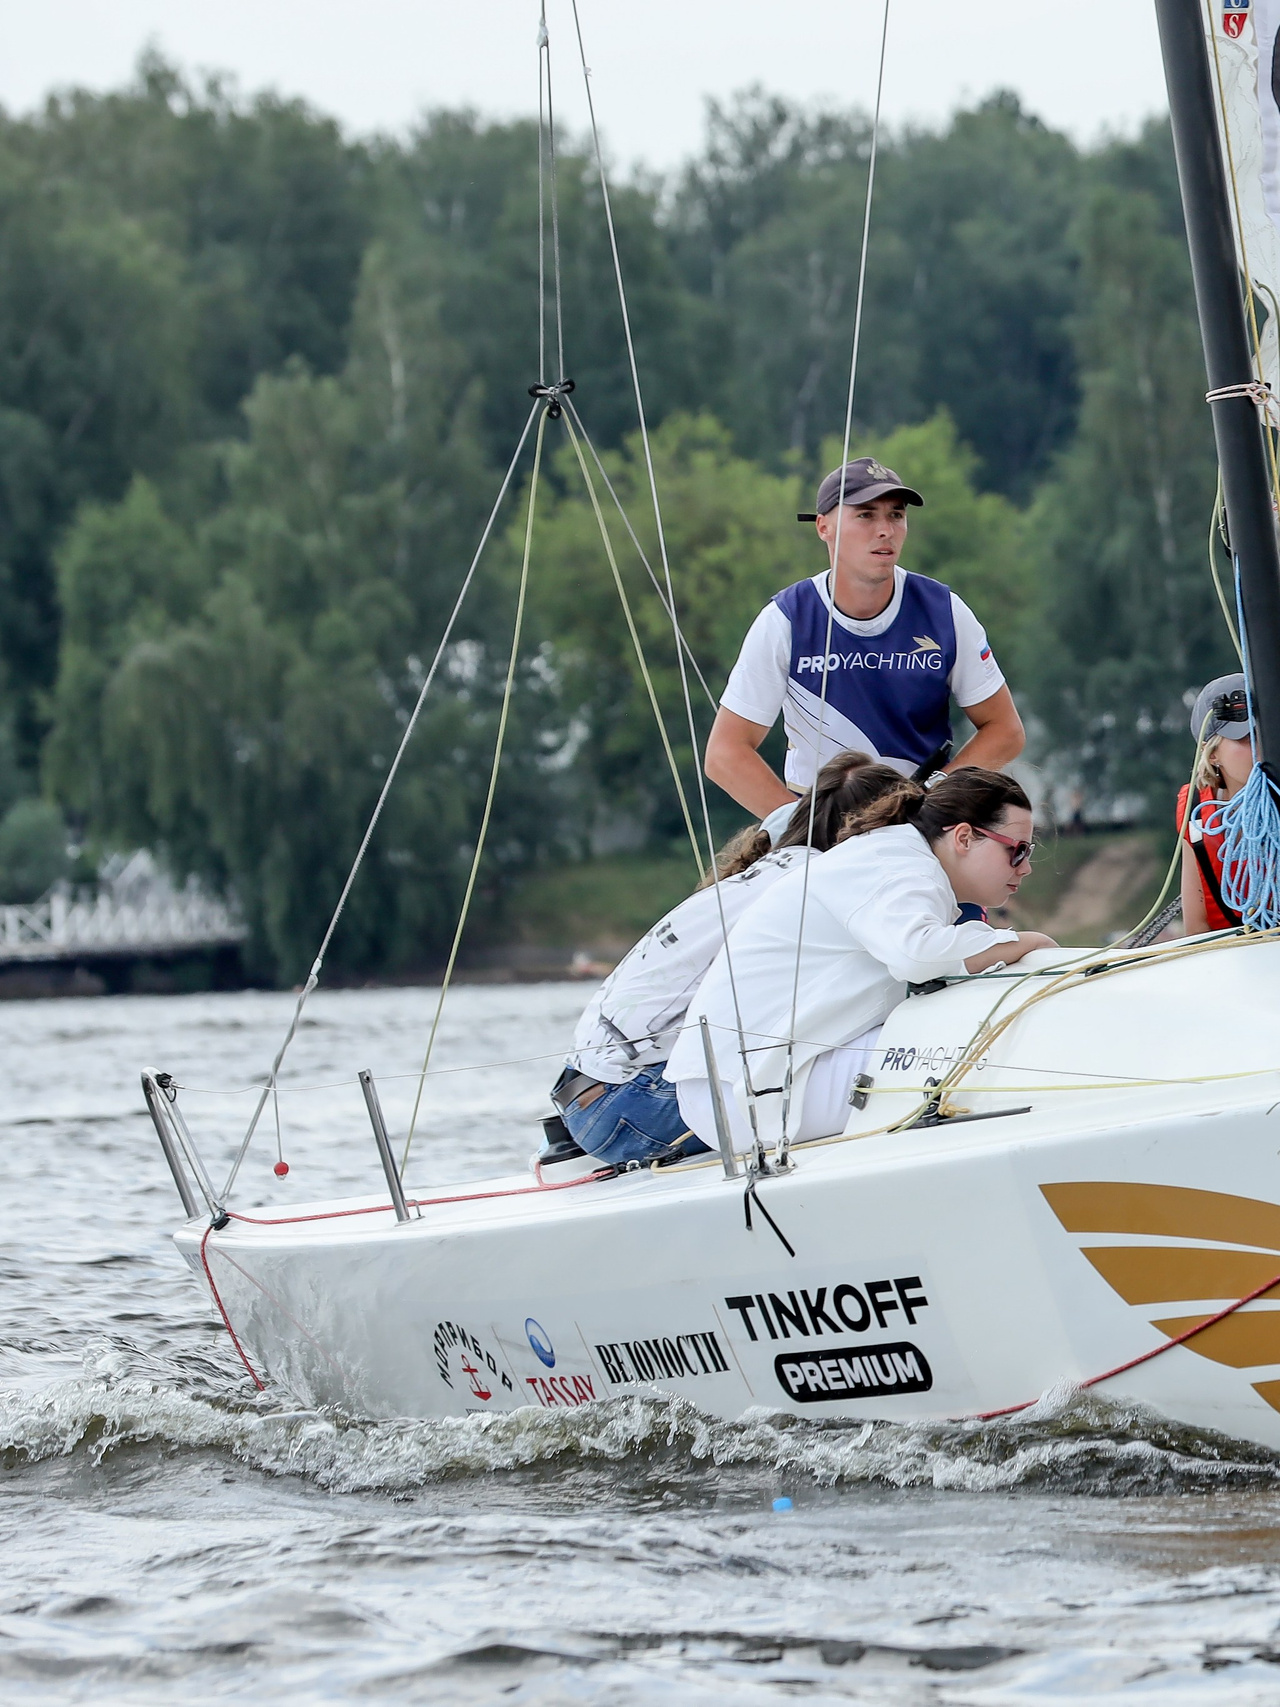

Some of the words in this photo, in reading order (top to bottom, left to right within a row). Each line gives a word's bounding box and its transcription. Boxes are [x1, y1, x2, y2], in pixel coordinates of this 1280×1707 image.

[796, 652, 943, 674] PROYACHTING
[880, 1047, 991, 1071] PROYACHTG
[724, 1276, 929, 1341] TINKOFF
[781, 1351, 924, 1394] PREMIUM
[525, 1374, 596, 1408] TASSAY
